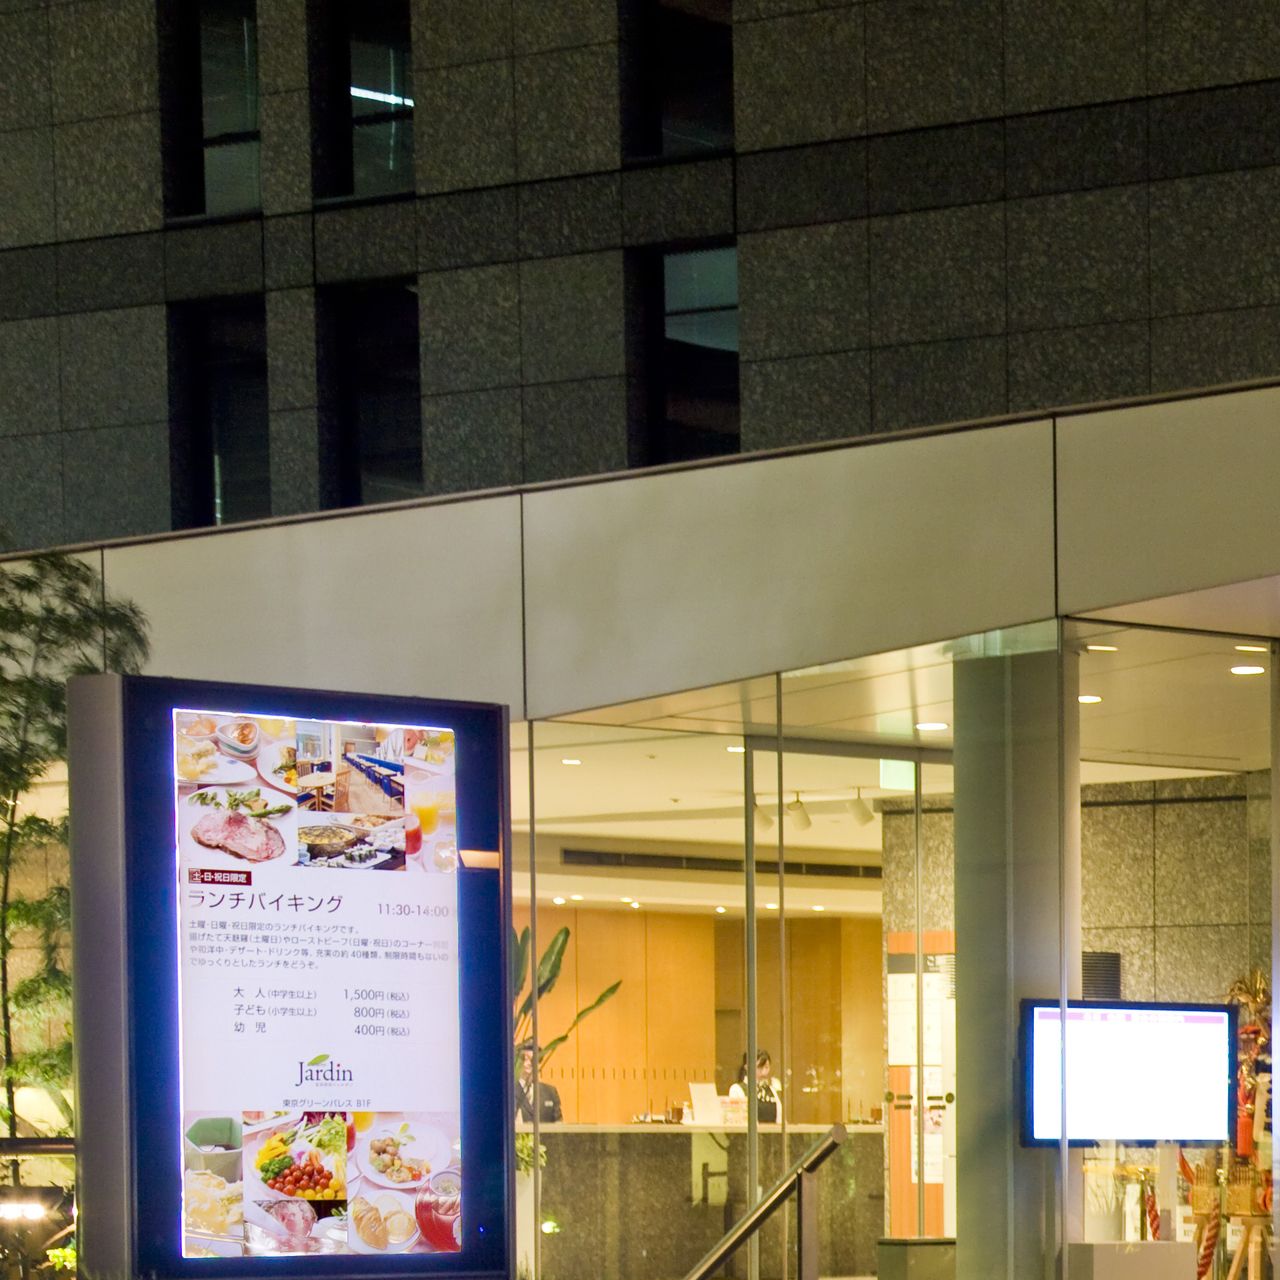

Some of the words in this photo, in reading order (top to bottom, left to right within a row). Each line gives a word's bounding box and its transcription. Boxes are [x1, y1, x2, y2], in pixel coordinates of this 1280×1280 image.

[188, 889, 344, 914] ランチバイキング
[378, 903, 450, 918] 11:30-14:00
[295, 1060, 354, 1087] Jardin
